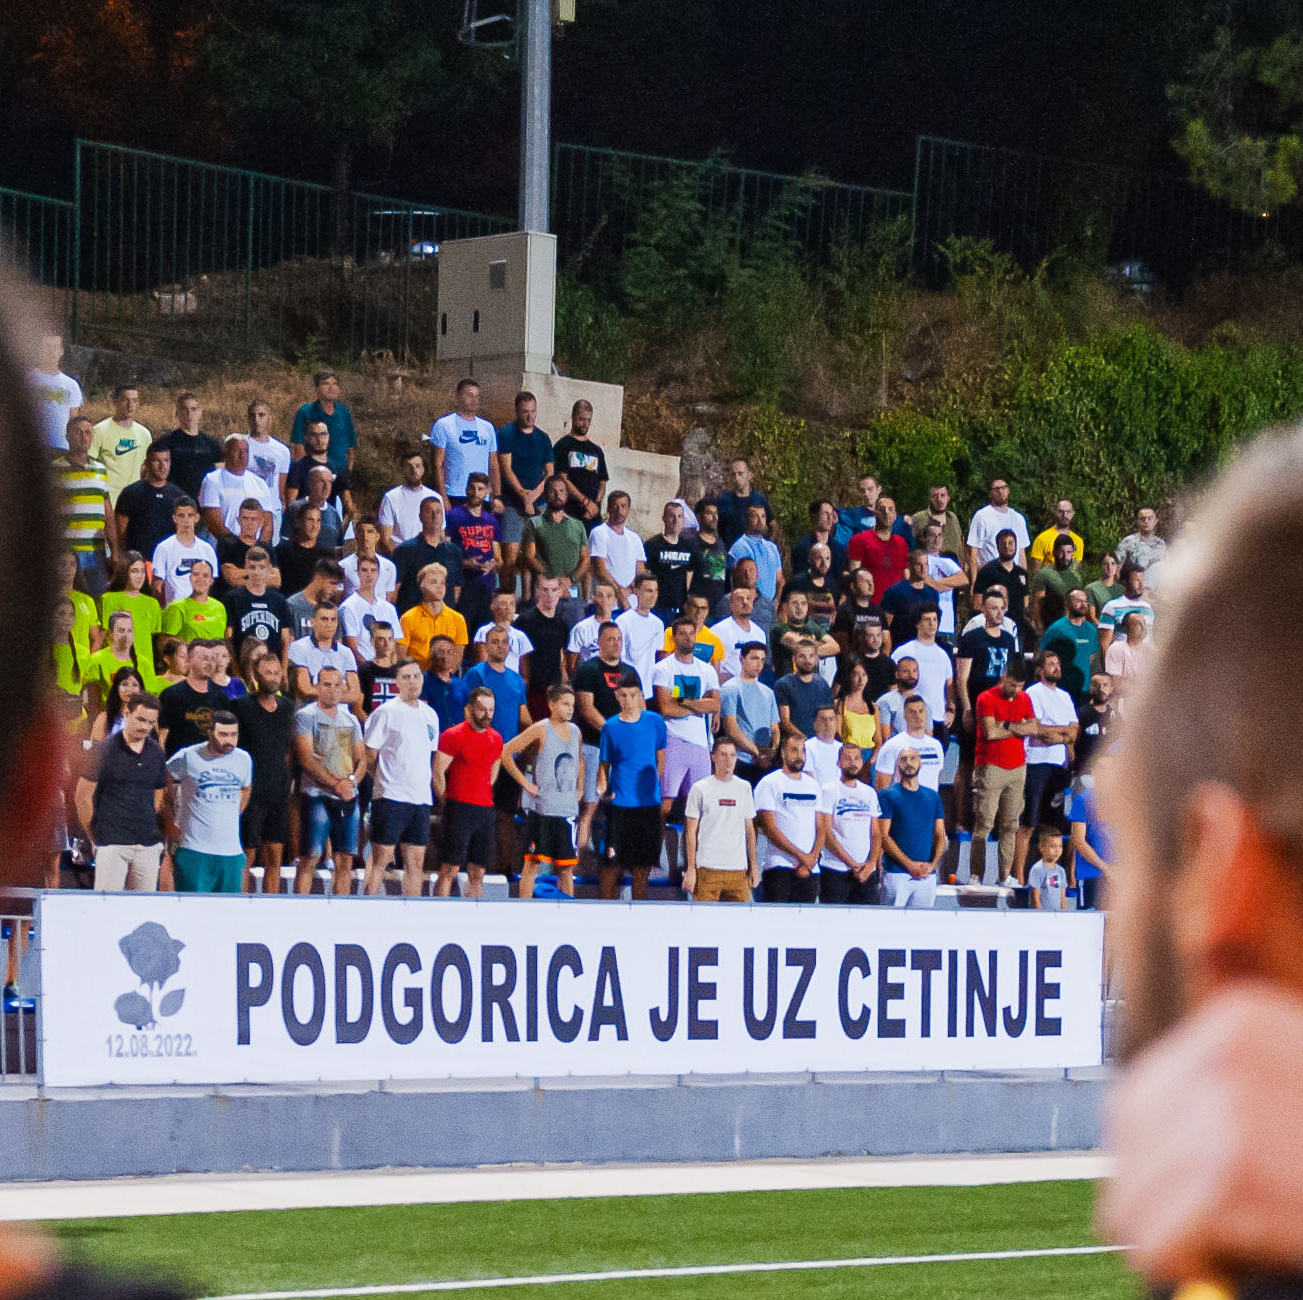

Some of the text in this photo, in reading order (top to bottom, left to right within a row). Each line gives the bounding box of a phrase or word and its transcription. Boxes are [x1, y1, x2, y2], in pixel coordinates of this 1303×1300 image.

[236, 941, 1063, 1047] PODGORICA JE UZ CETINJE
